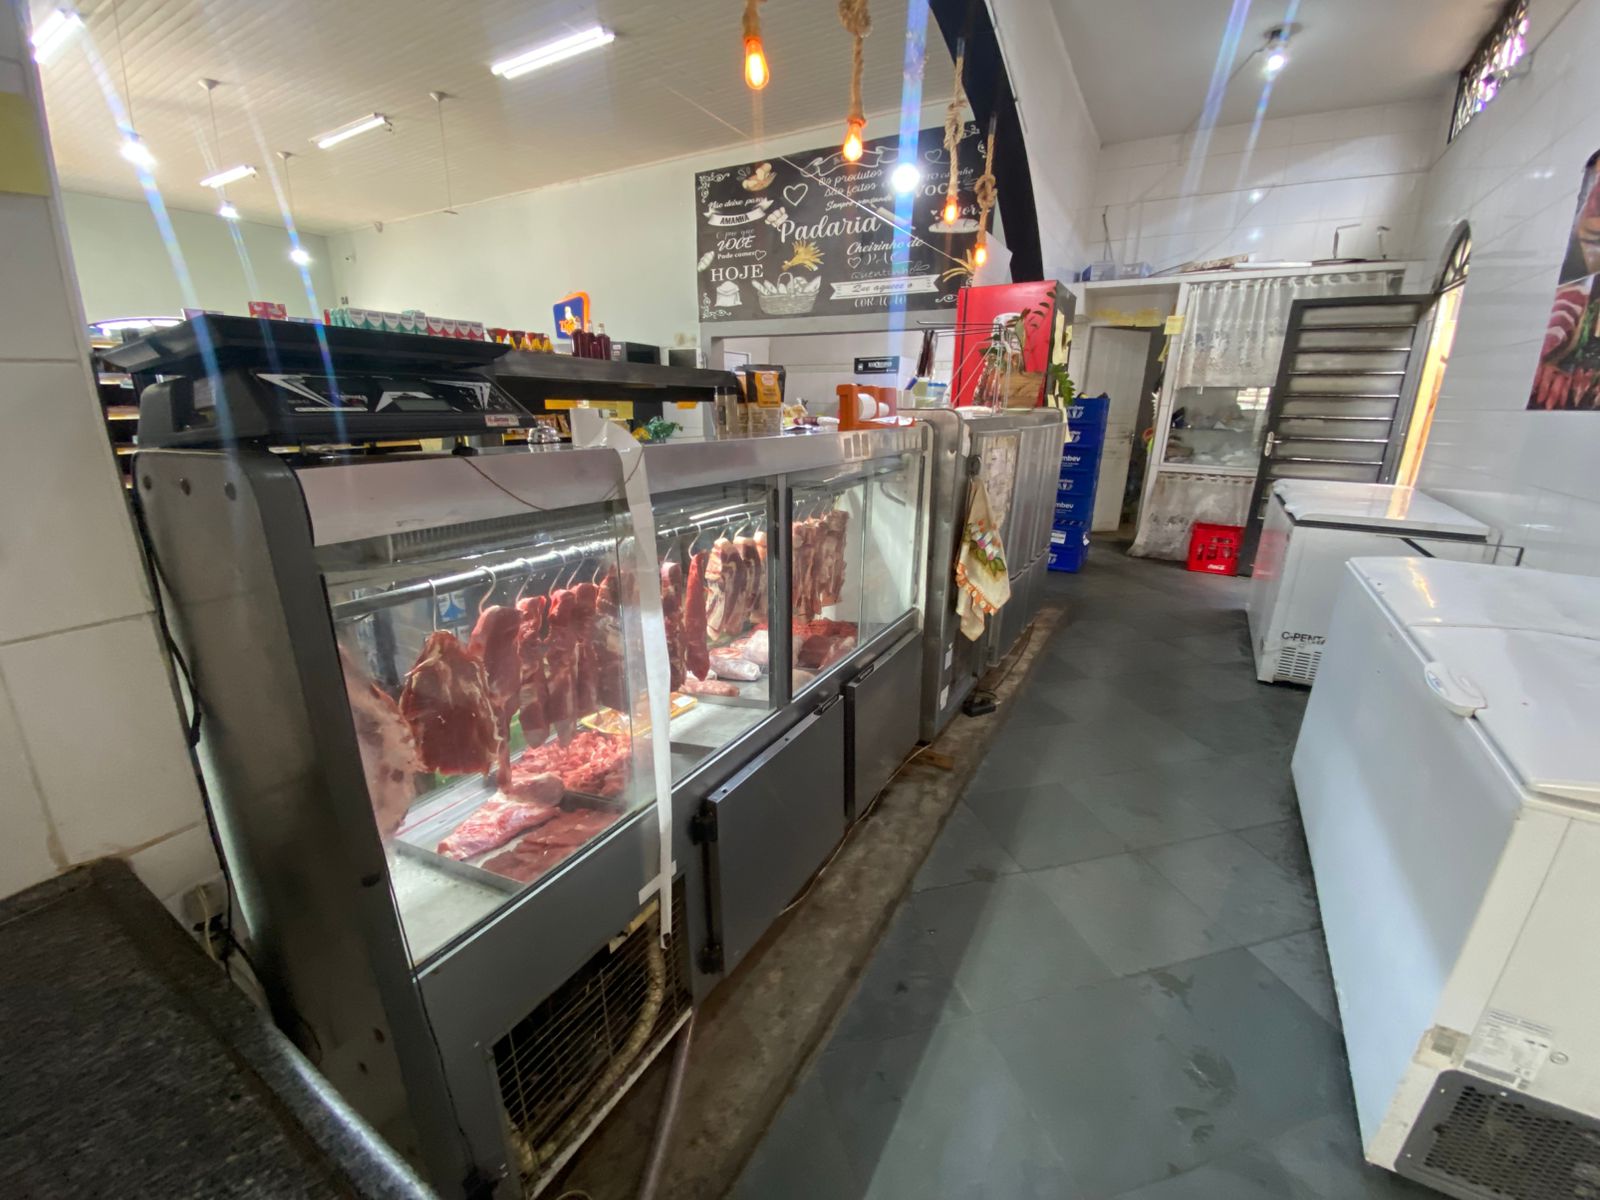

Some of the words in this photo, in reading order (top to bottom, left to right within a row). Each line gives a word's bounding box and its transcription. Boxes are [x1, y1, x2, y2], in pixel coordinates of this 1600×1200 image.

[834, 170, 883, 186] produtos
[779, 215, 882, 244] Padaria
[710, 264, 764, 282] HOJE
